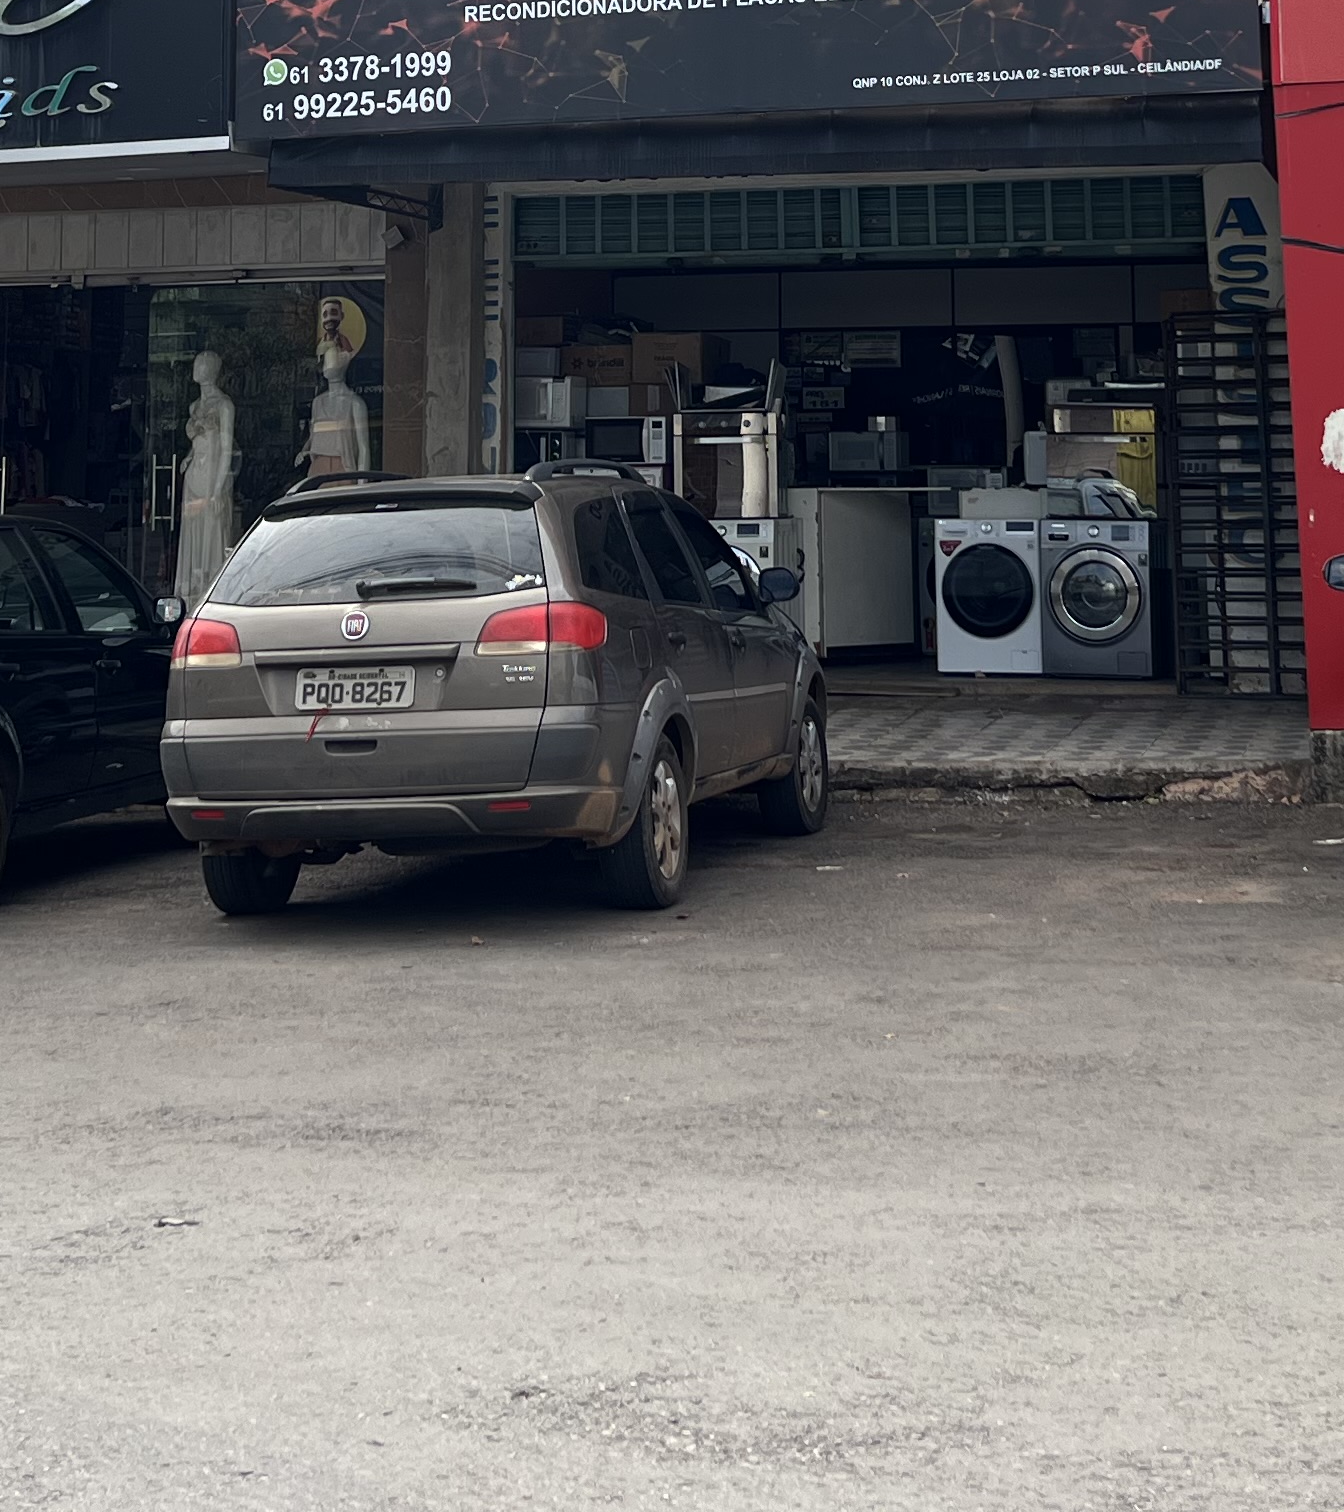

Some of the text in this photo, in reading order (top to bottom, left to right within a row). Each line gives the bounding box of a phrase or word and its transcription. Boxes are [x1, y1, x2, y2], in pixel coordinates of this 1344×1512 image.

[289, 50, 452, 85] 61 3378-1999
[852, 77, 877, 89] QNP
[880, 76, 893, 87] 10
[895, 74, 931, 87] CONJ.
[932, 73, 941, 84] Z
[943, 71, 974, 84] LOTE
[976, 71, 991, 82] 25
[993, 69, 1024, 81] LOJA
[1026, 68, 1040, 80] 02
[1049, 65, 1090, 79] SETOR
[1092, 65, 1101, 76] P
[1103, 63, 1128, 76] SUL
[1137, 59, 1223, 74] CEILÂNDIA/DF
[262, 86, 452, 122] 61 99225-5460
[346, 618, 364, 633] FIAT
